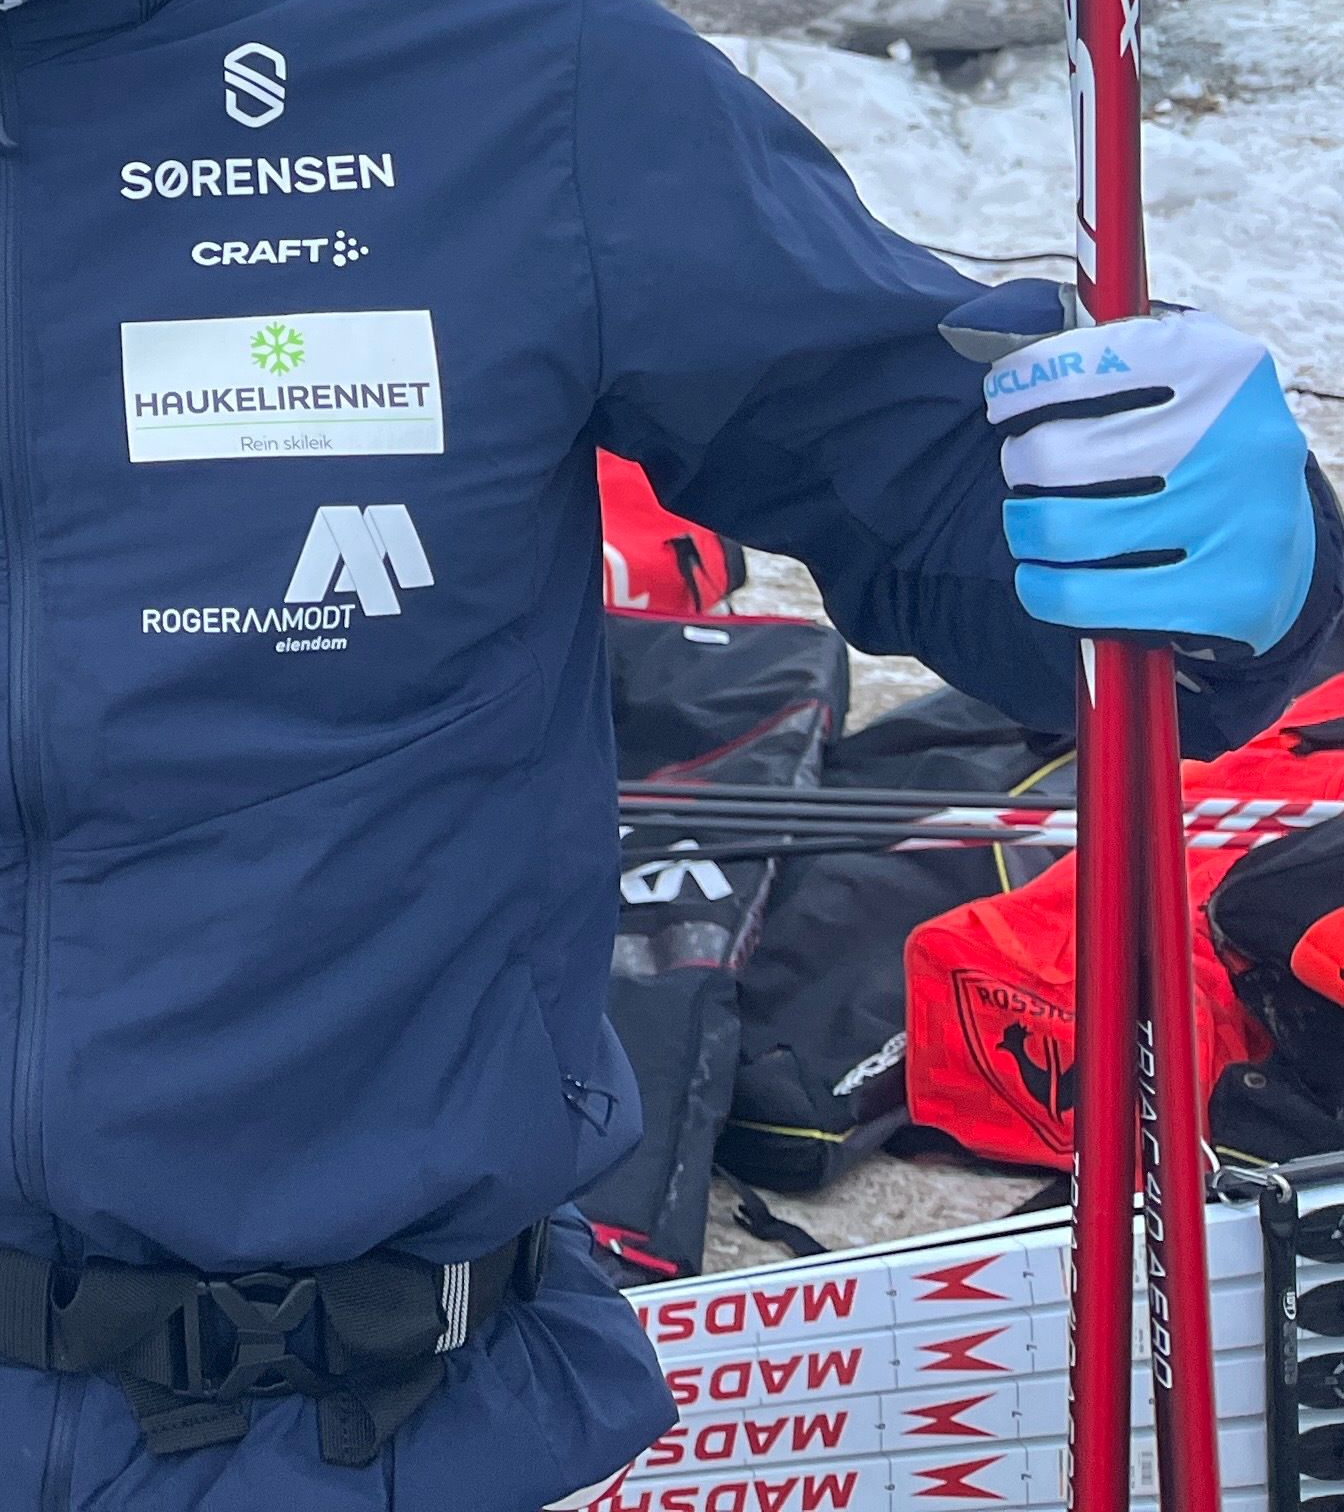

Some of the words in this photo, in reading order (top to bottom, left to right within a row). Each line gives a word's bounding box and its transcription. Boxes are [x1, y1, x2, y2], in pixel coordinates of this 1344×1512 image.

[121, 154, 394, 199] SØRENSEN
[192, 238, 328, 266] CRAFT
[135, 382, 430, 418] HAUKELIRENNET
[240, 434, 280, 452] Rein
[284, 431, 333, 452] skileik
[275, 636, 347, 652] eiendom
[1136, 1020, 1160, 1165] TRIAC
[639, 1278, 858, 1343] MADS
